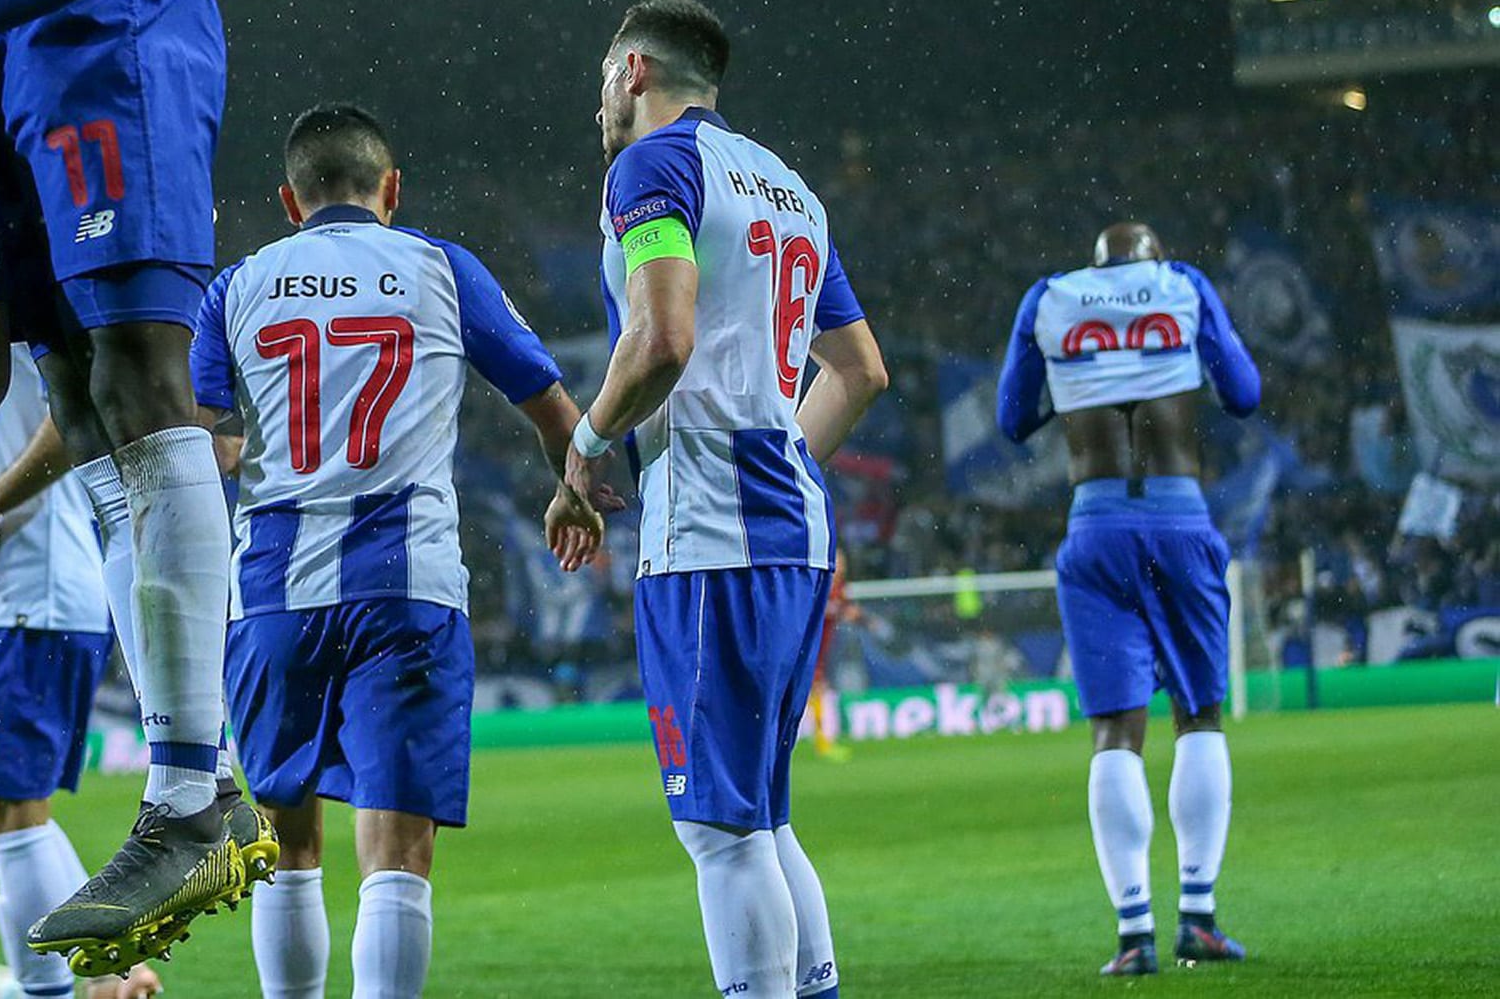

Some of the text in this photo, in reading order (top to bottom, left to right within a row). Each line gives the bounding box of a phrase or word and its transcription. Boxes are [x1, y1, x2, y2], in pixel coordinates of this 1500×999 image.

[46, 119, 124, 206] 11
[624, 199, 667, 225] RESPECT
[268, 273, 405, 300] JESUS C.
[255, 316, 414, 474] 17
[648, 705, 687, 769] 16
